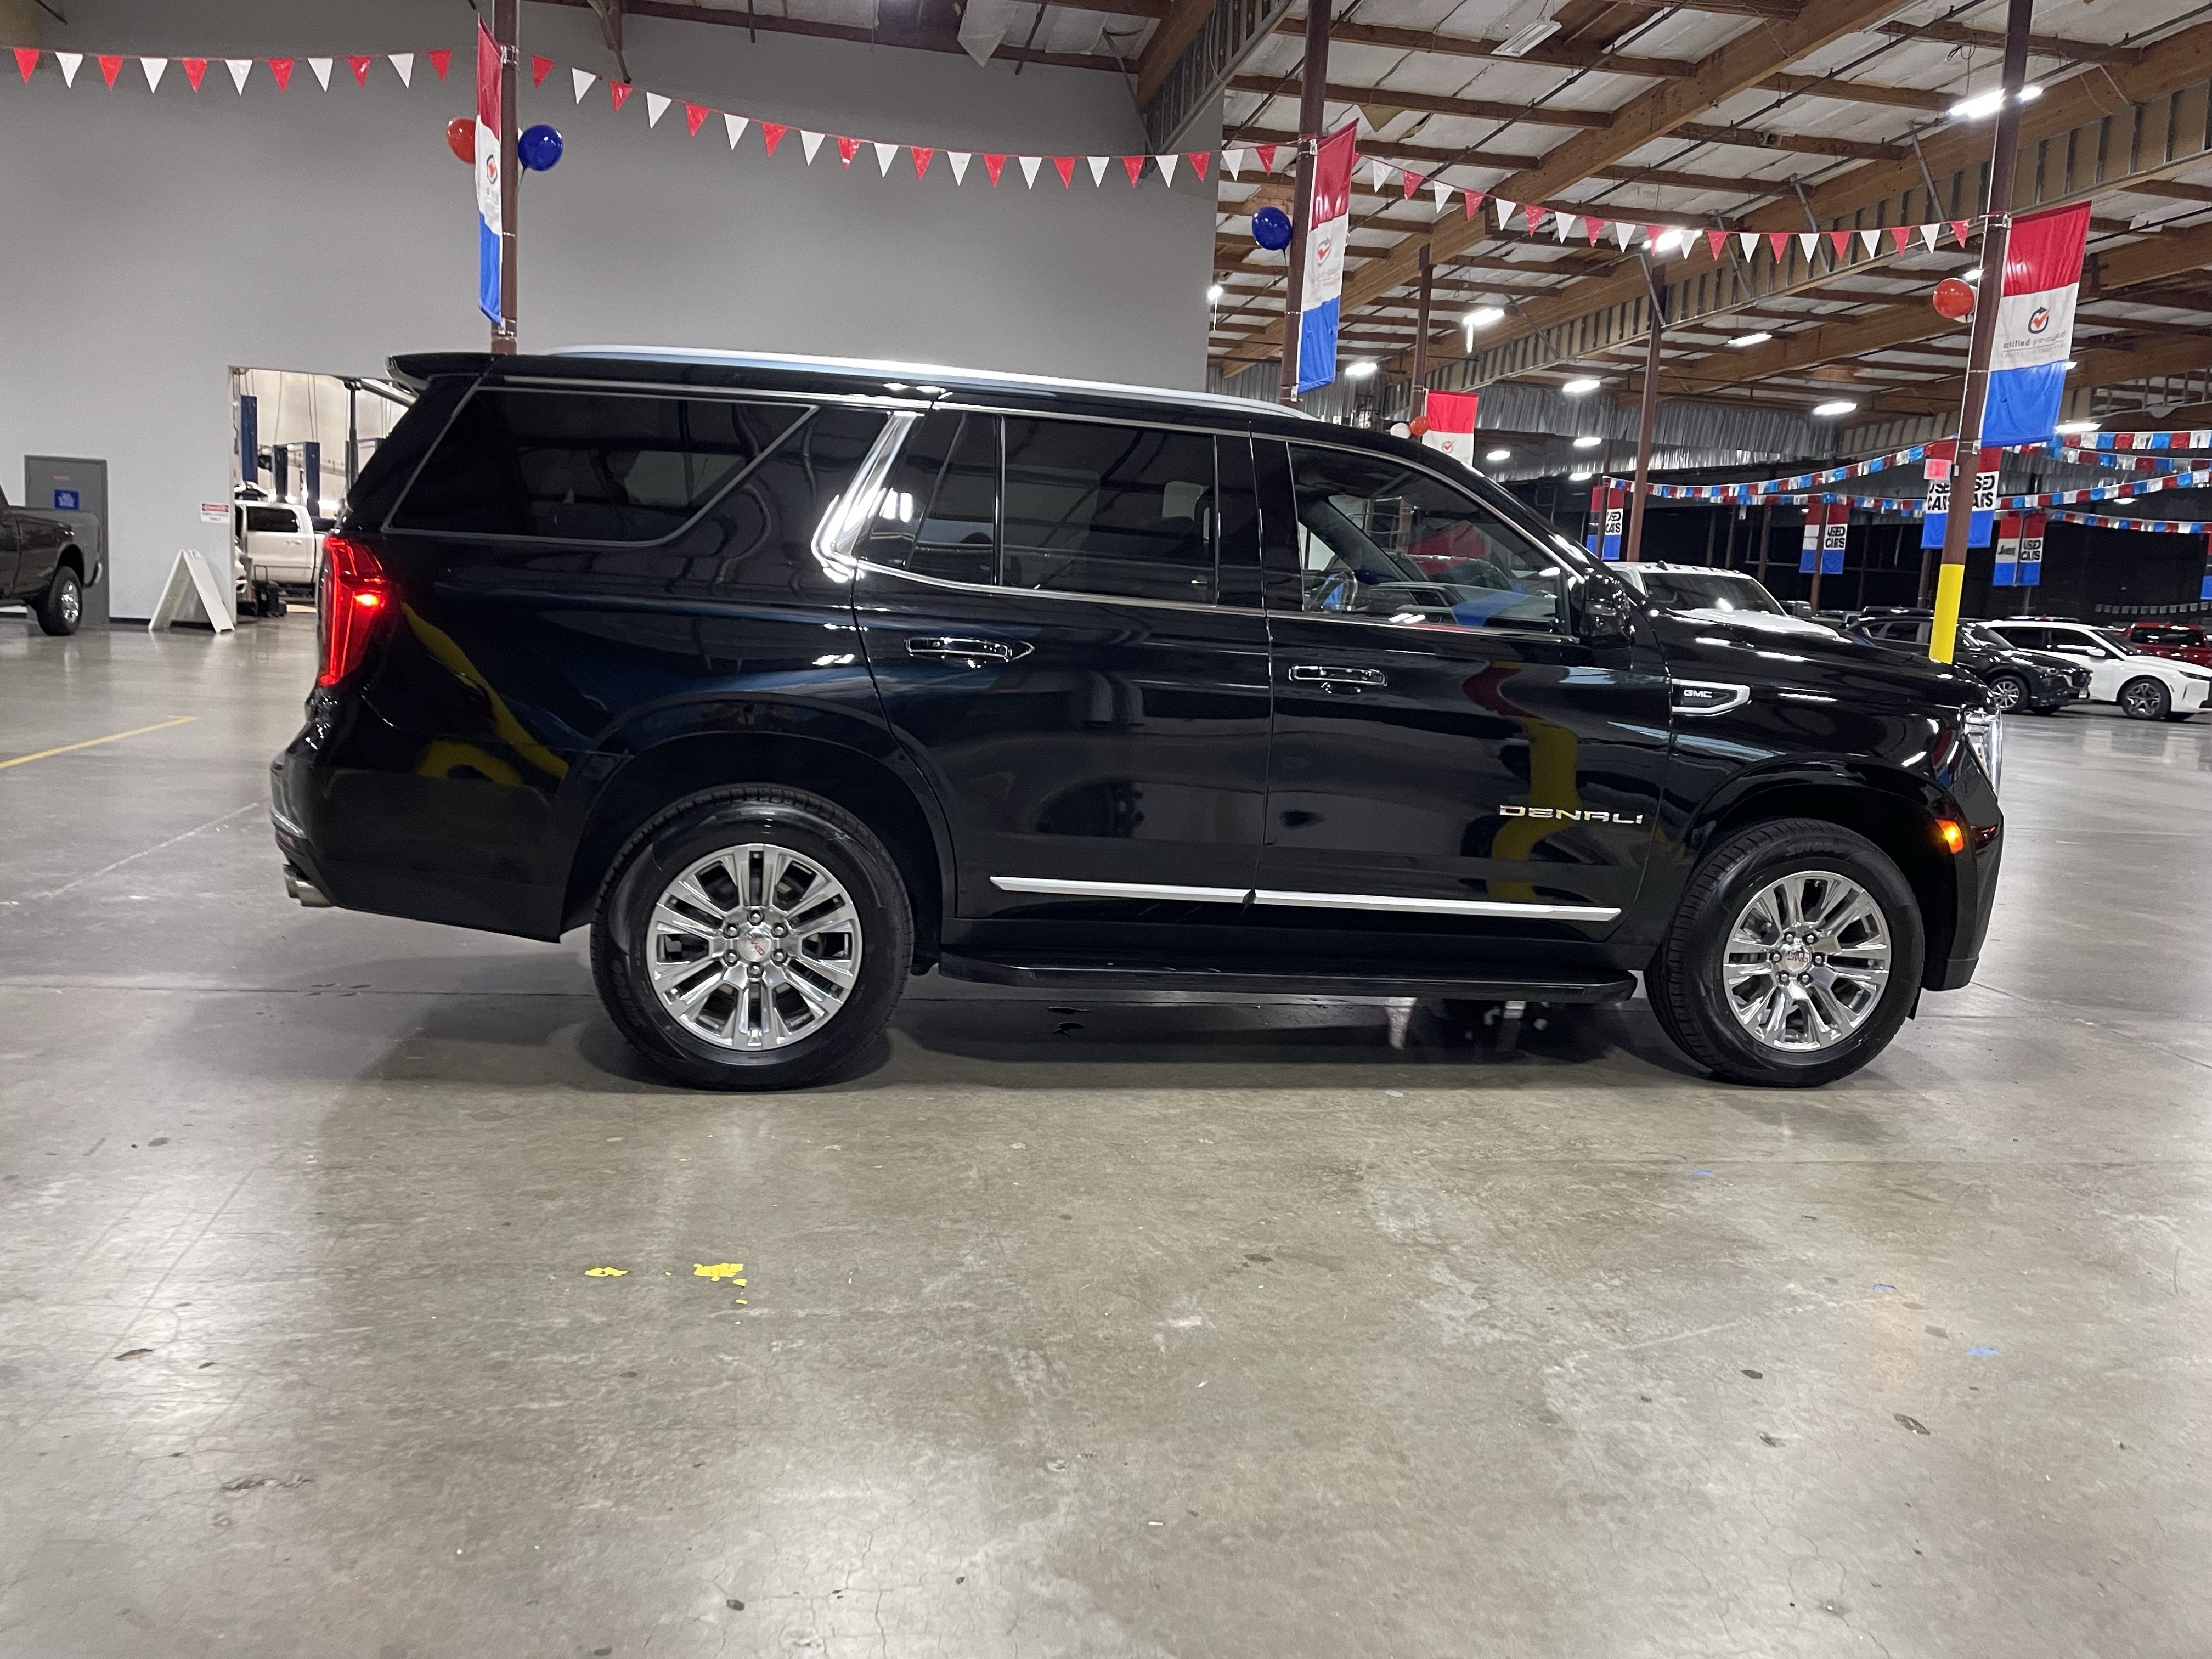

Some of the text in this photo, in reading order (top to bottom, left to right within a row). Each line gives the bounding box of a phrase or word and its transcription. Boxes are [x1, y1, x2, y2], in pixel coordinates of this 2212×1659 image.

[1975, 475, 1995, 491] SED
[1927, 495, 1948, 511] CAR
[1973, 492, 1994, 508] ARS
[1684, 689, 1712, 698] GMC
[1499, 805, 1643, 824] DENALI
[1787, 955, 1808, 963] GMC
